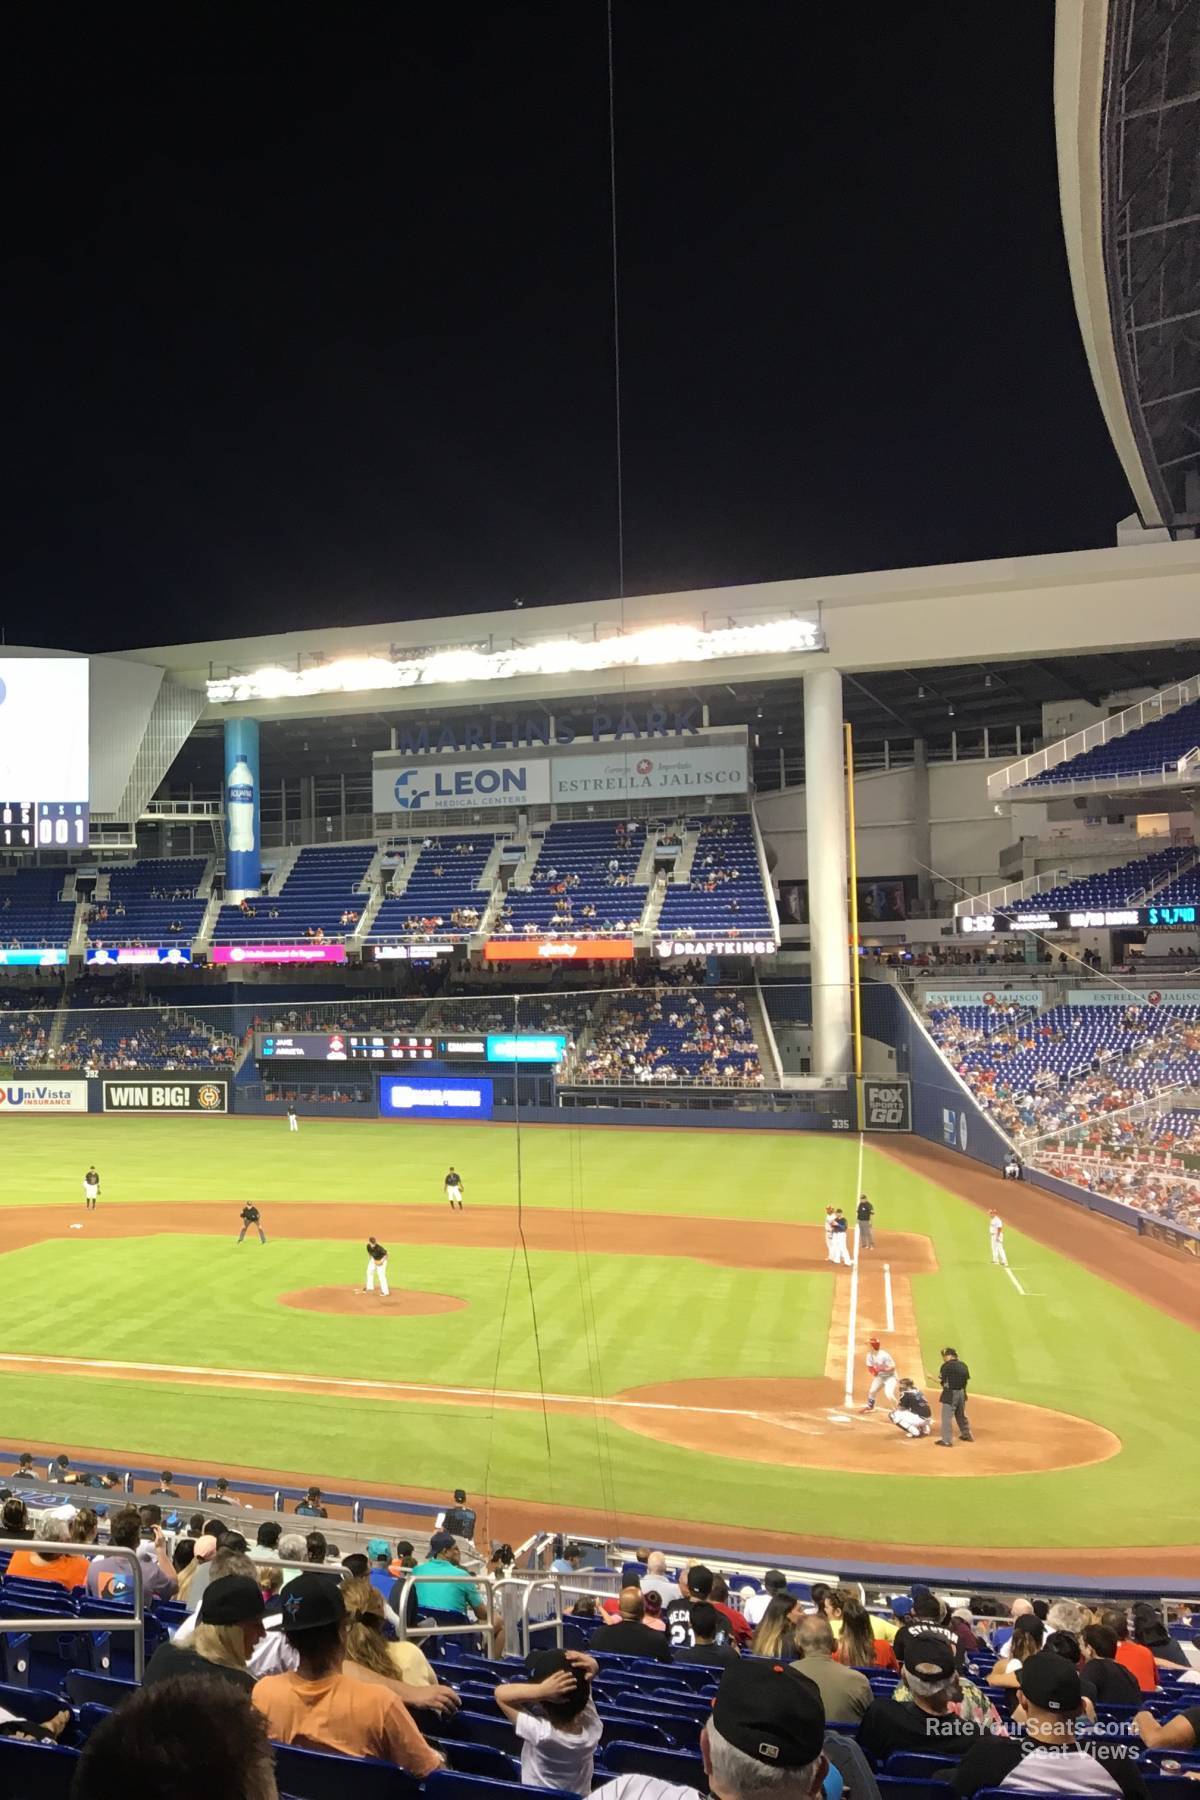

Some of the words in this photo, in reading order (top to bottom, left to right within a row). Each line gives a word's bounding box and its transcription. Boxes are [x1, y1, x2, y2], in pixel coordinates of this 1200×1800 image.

[401, 715, 575, 755] MARLINS
[593, 706, 699, 742] PARK
[435, 767, 527, 796] LEON
[558, 774, 652, 792] ESTRELLA
[660, 770, 741, 787] JALISCO
[435, 799, 479, 808] MEDICAL
[481, 796, 527, 806] CENTERS
[674, 941, 776, 955] DRAFTKINGS
[110, 1087, 148, 1106] WIN
[152, 1086, 190, 1106] BIG!
[868, 1088, 902, 1102] FOX
[870, 1109, 903, 1123] GO
[832, 1120, 849, 1129] 335
